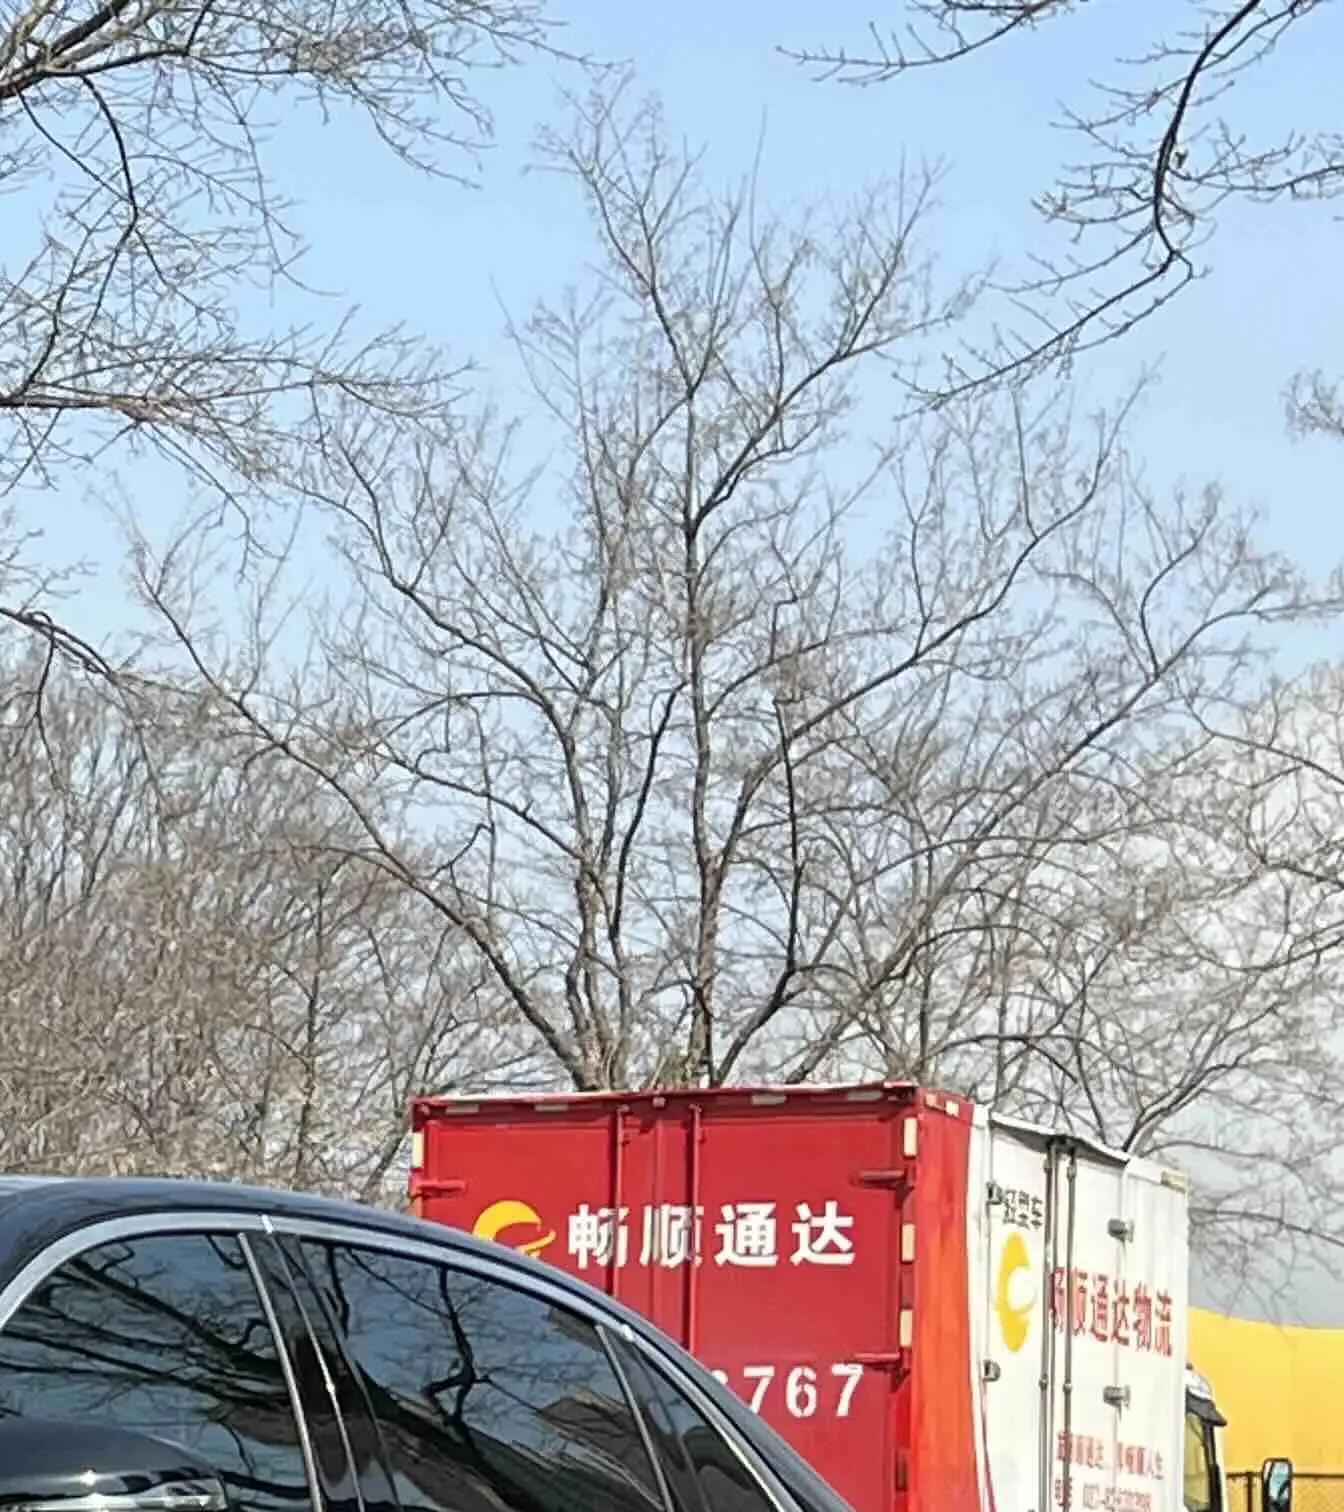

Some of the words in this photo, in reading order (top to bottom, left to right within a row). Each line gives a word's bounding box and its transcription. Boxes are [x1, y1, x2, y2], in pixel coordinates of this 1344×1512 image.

[568, 1200, 856, 1269] 畅顺通达
[712, 1362, 865, 1418] 767
